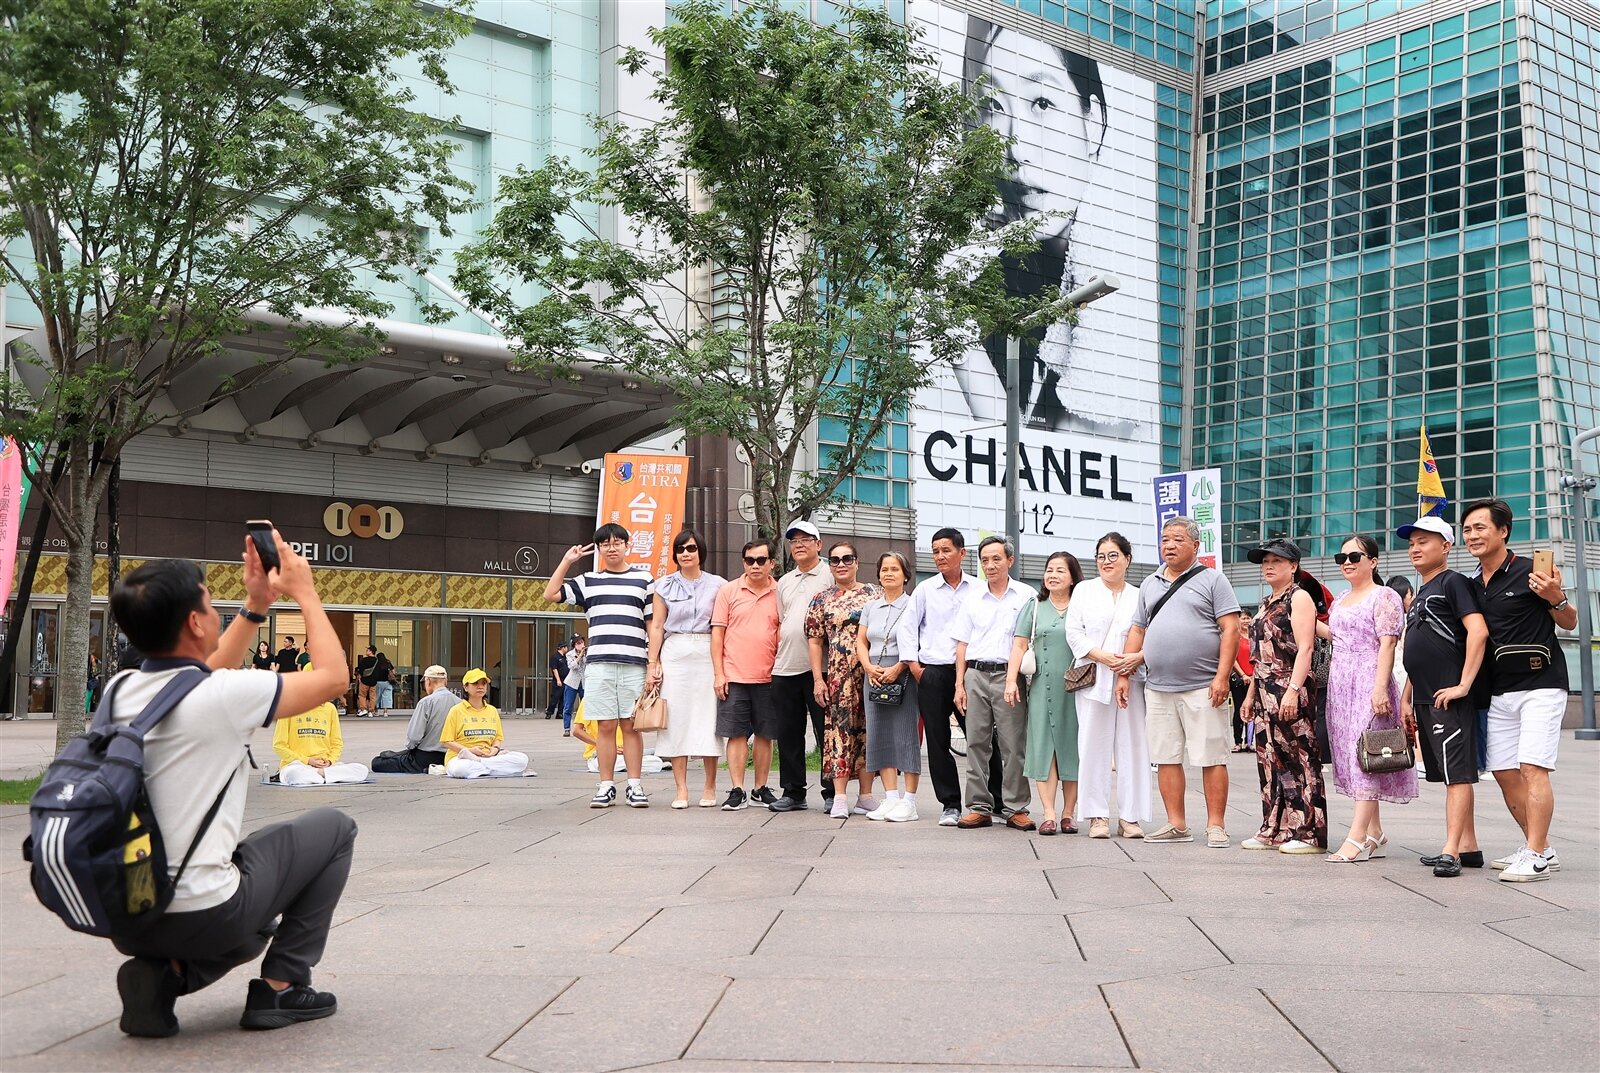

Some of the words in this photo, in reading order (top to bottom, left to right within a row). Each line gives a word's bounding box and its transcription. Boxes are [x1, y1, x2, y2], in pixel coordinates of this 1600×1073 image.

[639, 463, 682, 475] 台灣共和國
[923, 430, 1133, 502] CHANEL
[639, 475, 680, 487] TIRA
[624, 492, 658, 572] 台灣
[523, 551, 531, 564] S
[484, 560, 513, 572] MALL
